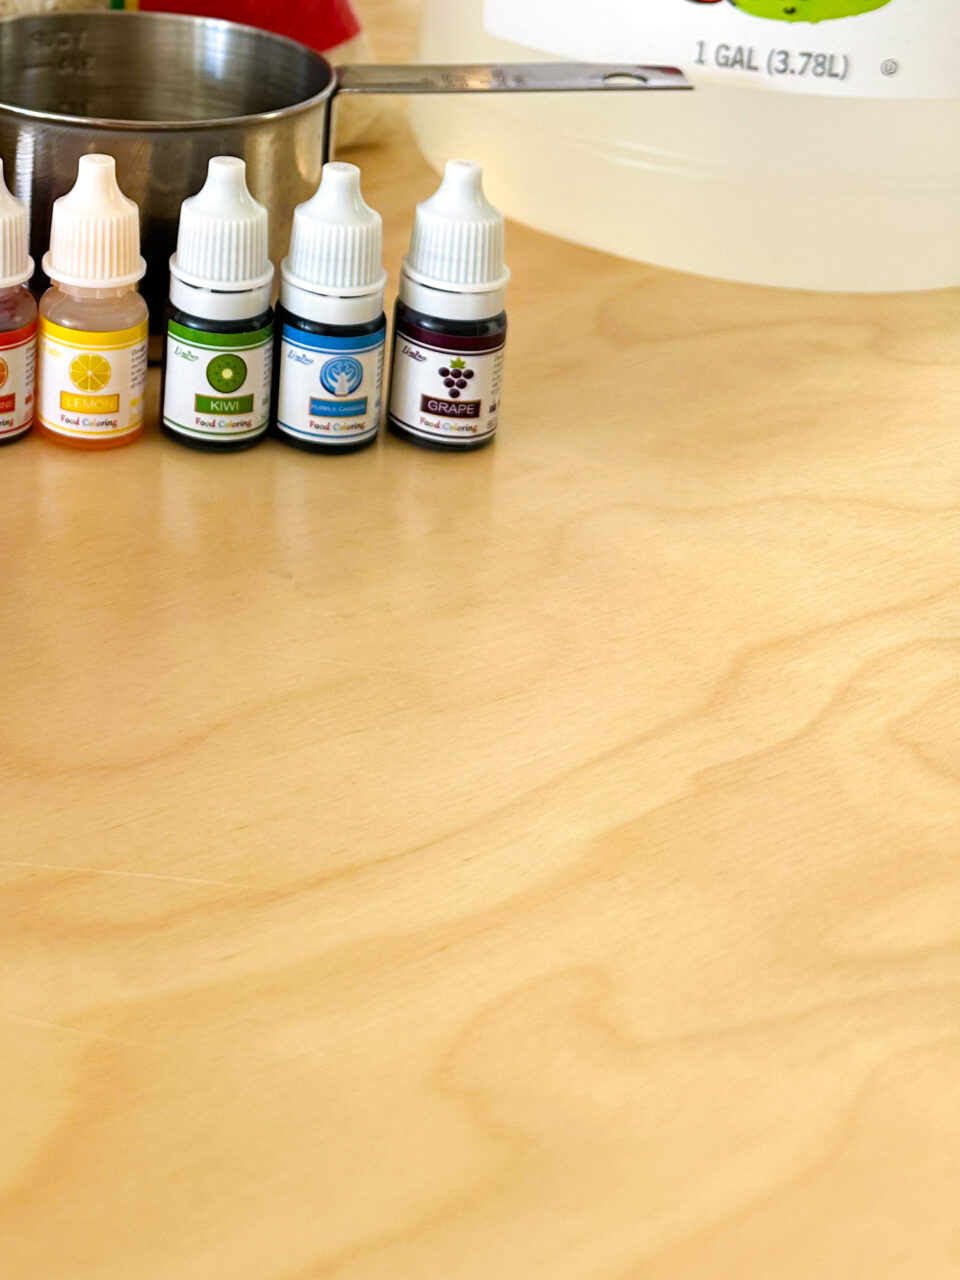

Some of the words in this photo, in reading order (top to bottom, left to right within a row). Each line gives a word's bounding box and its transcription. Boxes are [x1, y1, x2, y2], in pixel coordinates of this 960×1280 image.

[695, 40, 707, 65] 1
[714, 44, 759, 72] GAL
[766, 47, 849, 81] (3.78L)
[66, 398, 115, 410] LEMON
[210, 400, 240, 412] KIWI
[427, 399, 476, 415] GRAPE
[60, 414, 80, 426] Food
[82, 417, 119, 429] Coloring
[195, 416, 216, 428] Food
[218, 418, 252, 429] Coloring
[309, 420, 330, 431] Food
[332, 421, 366, 431] Coloring
[419, 416, 441, 430] Food
[442, 421, 480, 434] Coloring
